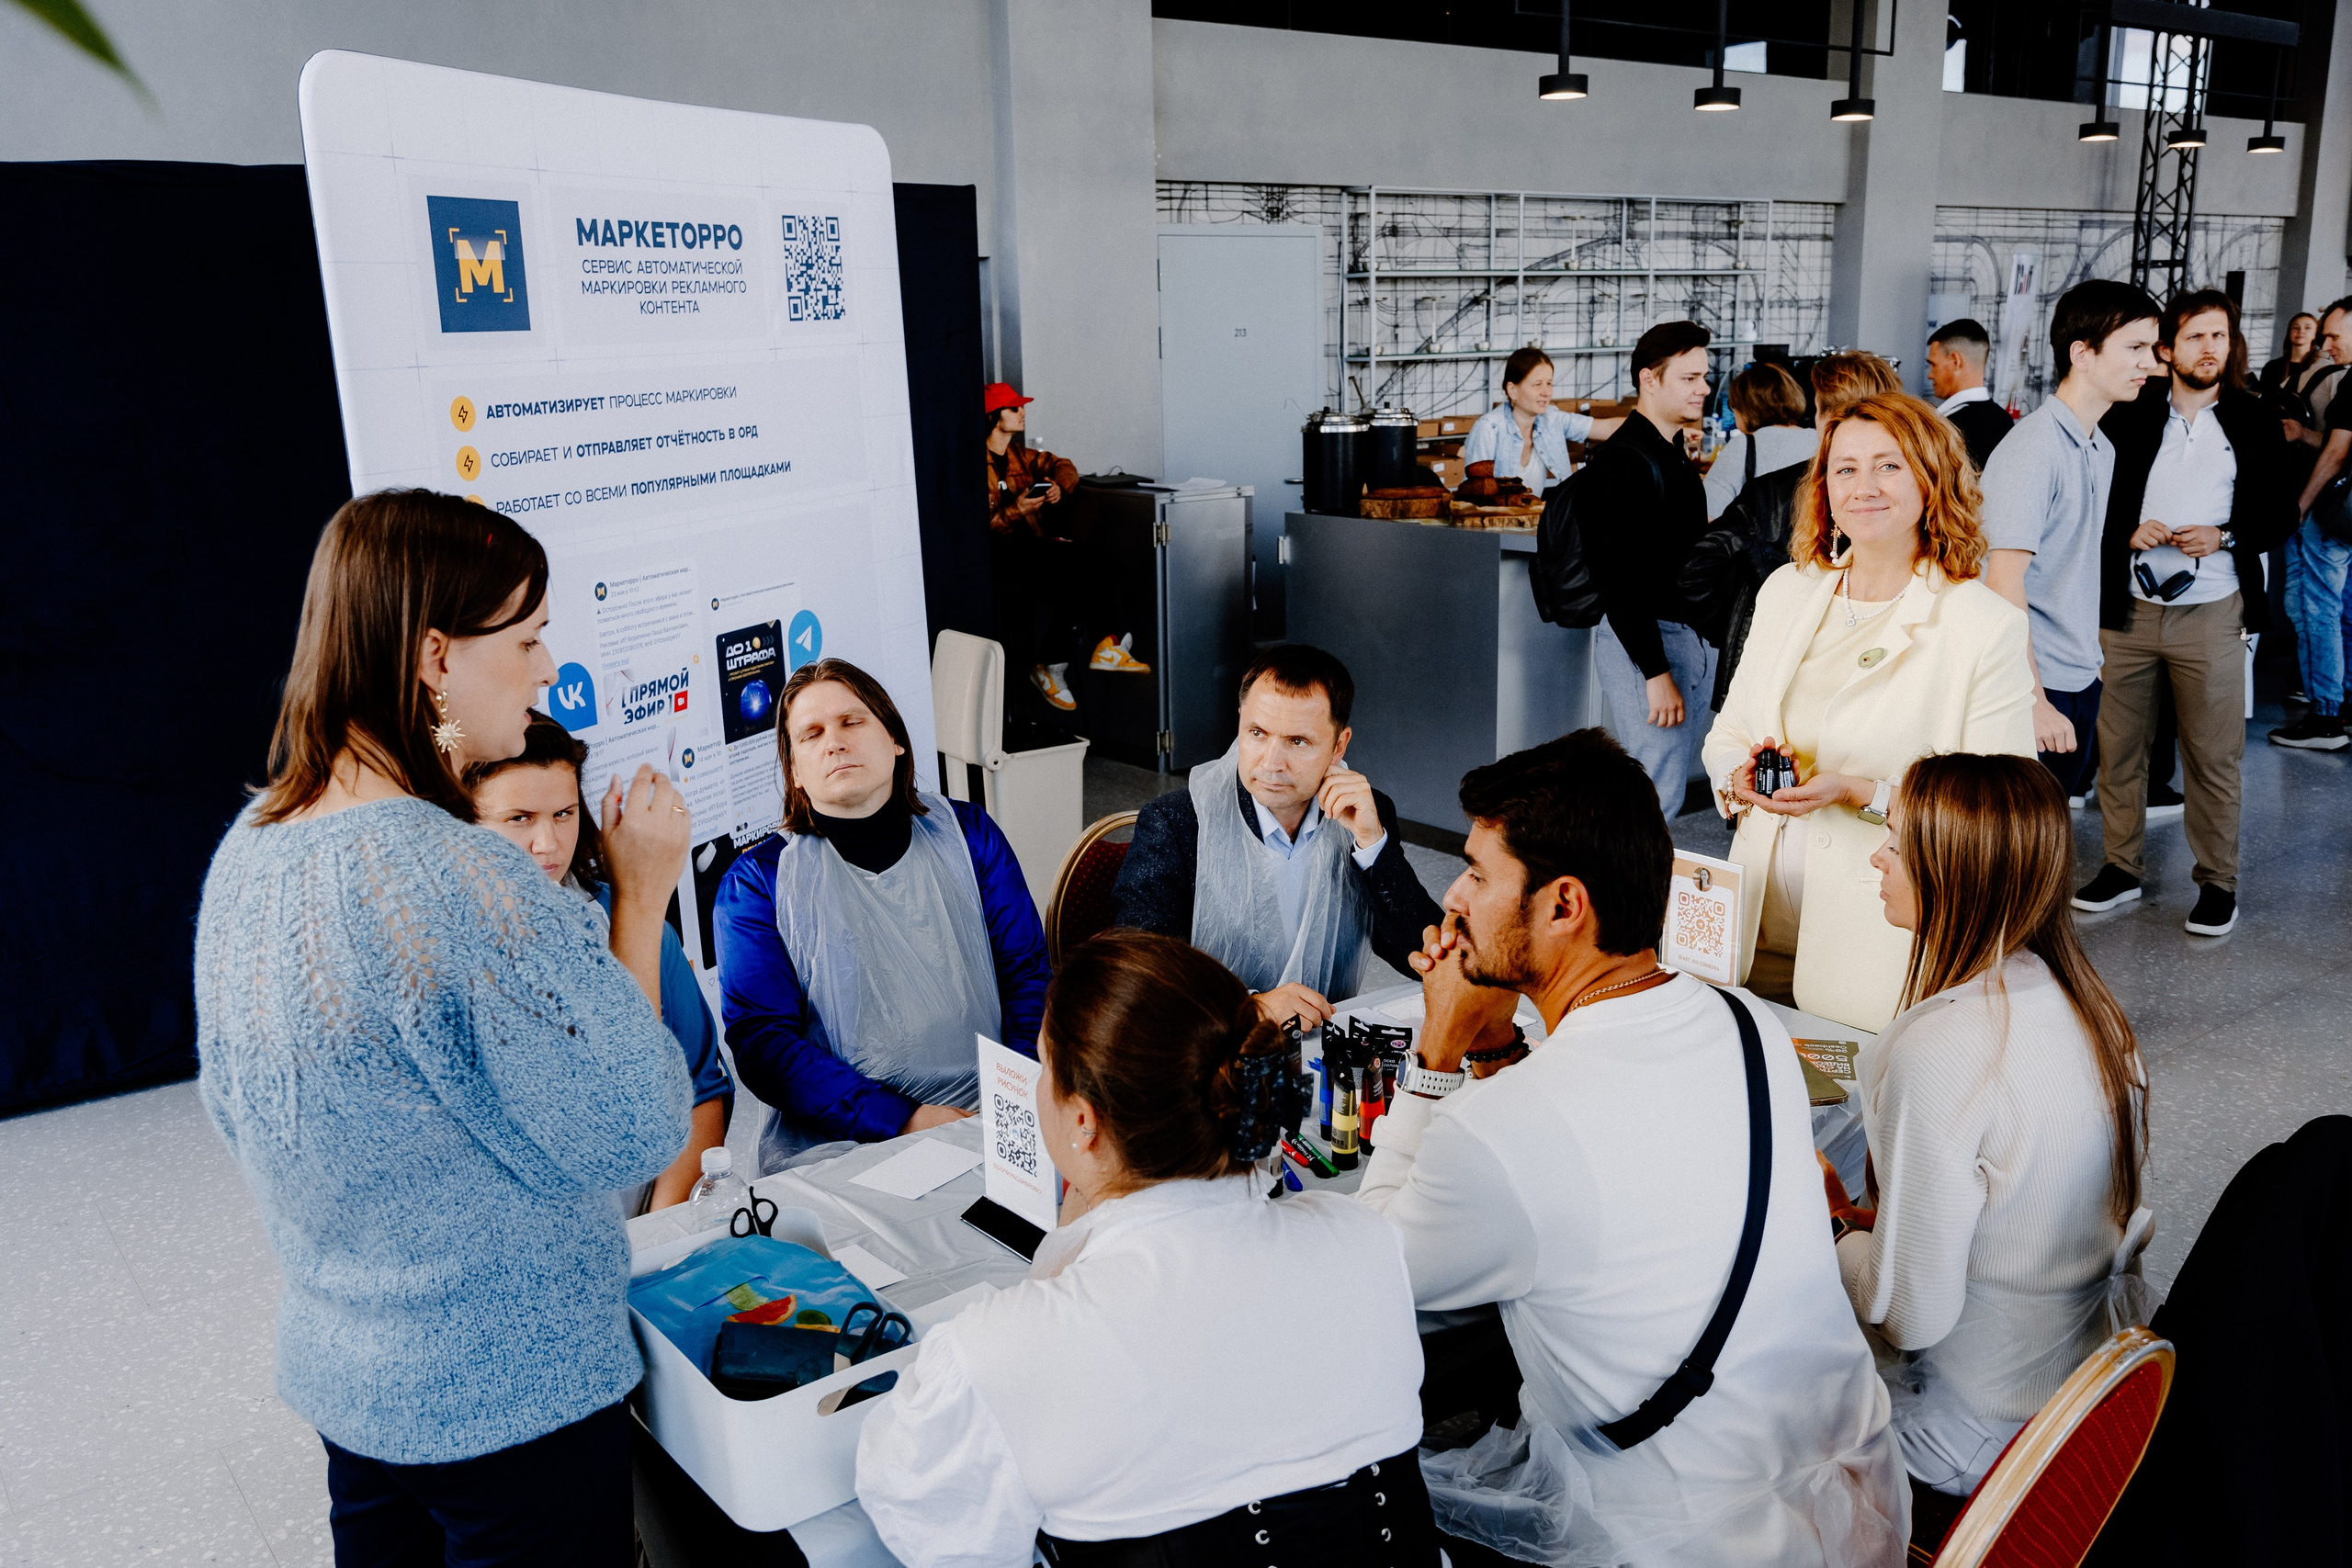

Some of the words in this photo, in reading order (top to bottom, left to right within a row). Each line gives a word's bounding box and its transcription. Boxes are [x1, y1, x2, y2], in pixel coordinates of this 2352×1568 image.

[576, 218, 743, 251] МАРКЕТОРРО
[582, 259, 632, 275] СЕРВИС
[638, 258, 743, 275] АВТОМАТИЧЕСКОЙ
[581, 279, 668, 295] МАРКИРОВКИ
[672, 280, 747, 294] РЕКЛАМНОГО
[639, 299, 700, 314] КОНТЕНТА
[1235, 328, 1248, 338] 213
[486, 396, 605, 420] АВТОМАТИЗИРУЕТ
[609, 391, 663, 410] ПРОЦЕСС
[666, 386, 738, 404] МАРКИРОВКИ
[491, 446, 559, 468] СОБИРАЕТ
[563, 446, 572, 459] И
[576, 436, 652, 458] ОТПРАВЛЯЕТ
[656, 428, 726, 449] ОТЧЁТНОСТЬ
[729, 427, 736, 439] В
[739, 425, 759, 439] ОРД
[496, 492, 560, 514] РАБОТАЕТ
[564, 491, 582, 506] СО
[586, 484, 628, 503] ВСЕМИ
[630, 471, 717, 496] ПОПУЛЯРНЫМИ
[719, 460, 792, 484] ПЛОЩАДКАМИ
[725, 642, 744, 658] ДО
[726, 647, 776, 671] ШТРАФА
[624, 699, 665, 725] ЭФИР
[608, 728, 647, 743] Автоматическая
[996, 1062, 1027, 1085] ВЫЛОЖИ
[997, 1077, 1029, 1100] РИСУНОК
